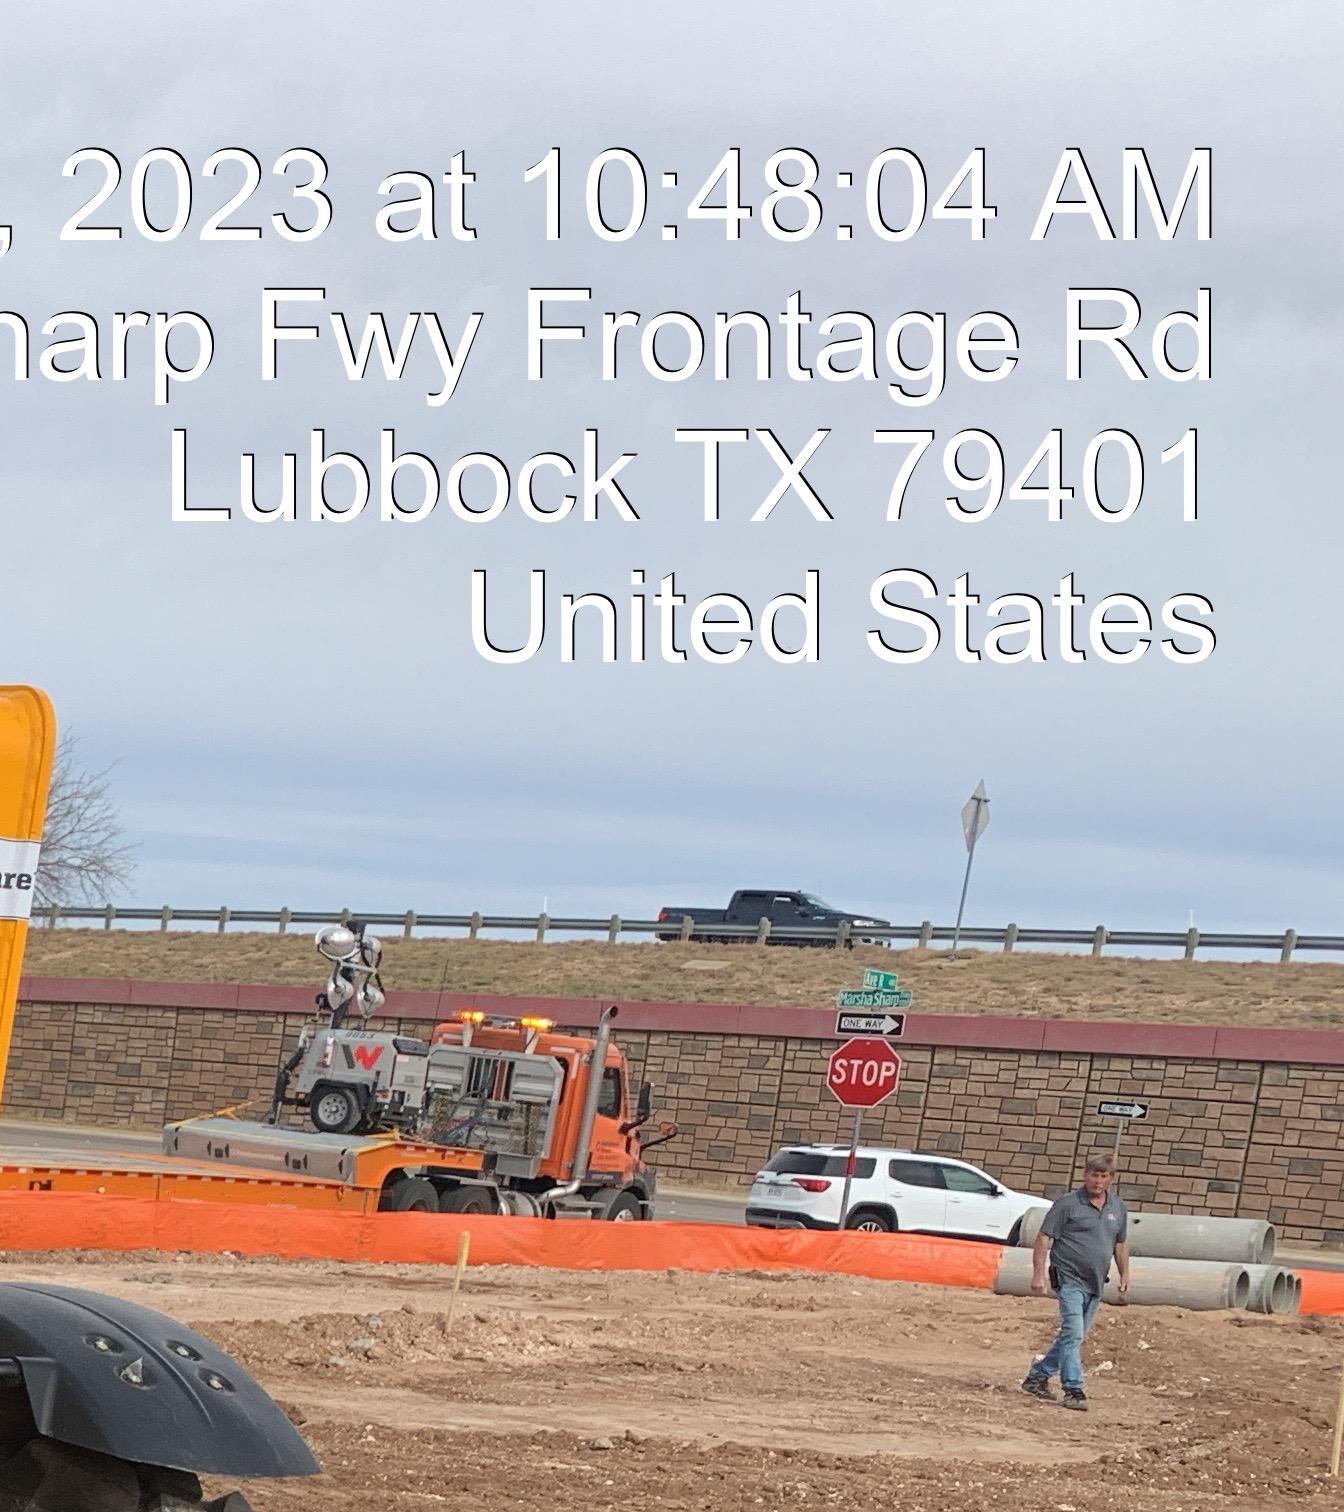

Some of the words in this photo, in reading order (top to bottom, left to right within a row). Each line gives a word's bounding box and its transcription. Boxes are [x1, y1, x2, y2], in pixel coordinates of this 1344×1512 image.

[839, 991, 872, 1006] Marsha
[873, 991, 899, 1007] Sharp
[843, 1018, 863, 1028] ONE
[864, 1018, 884, 1029] WAY
[831, 1058, 896, 1087] STOP
